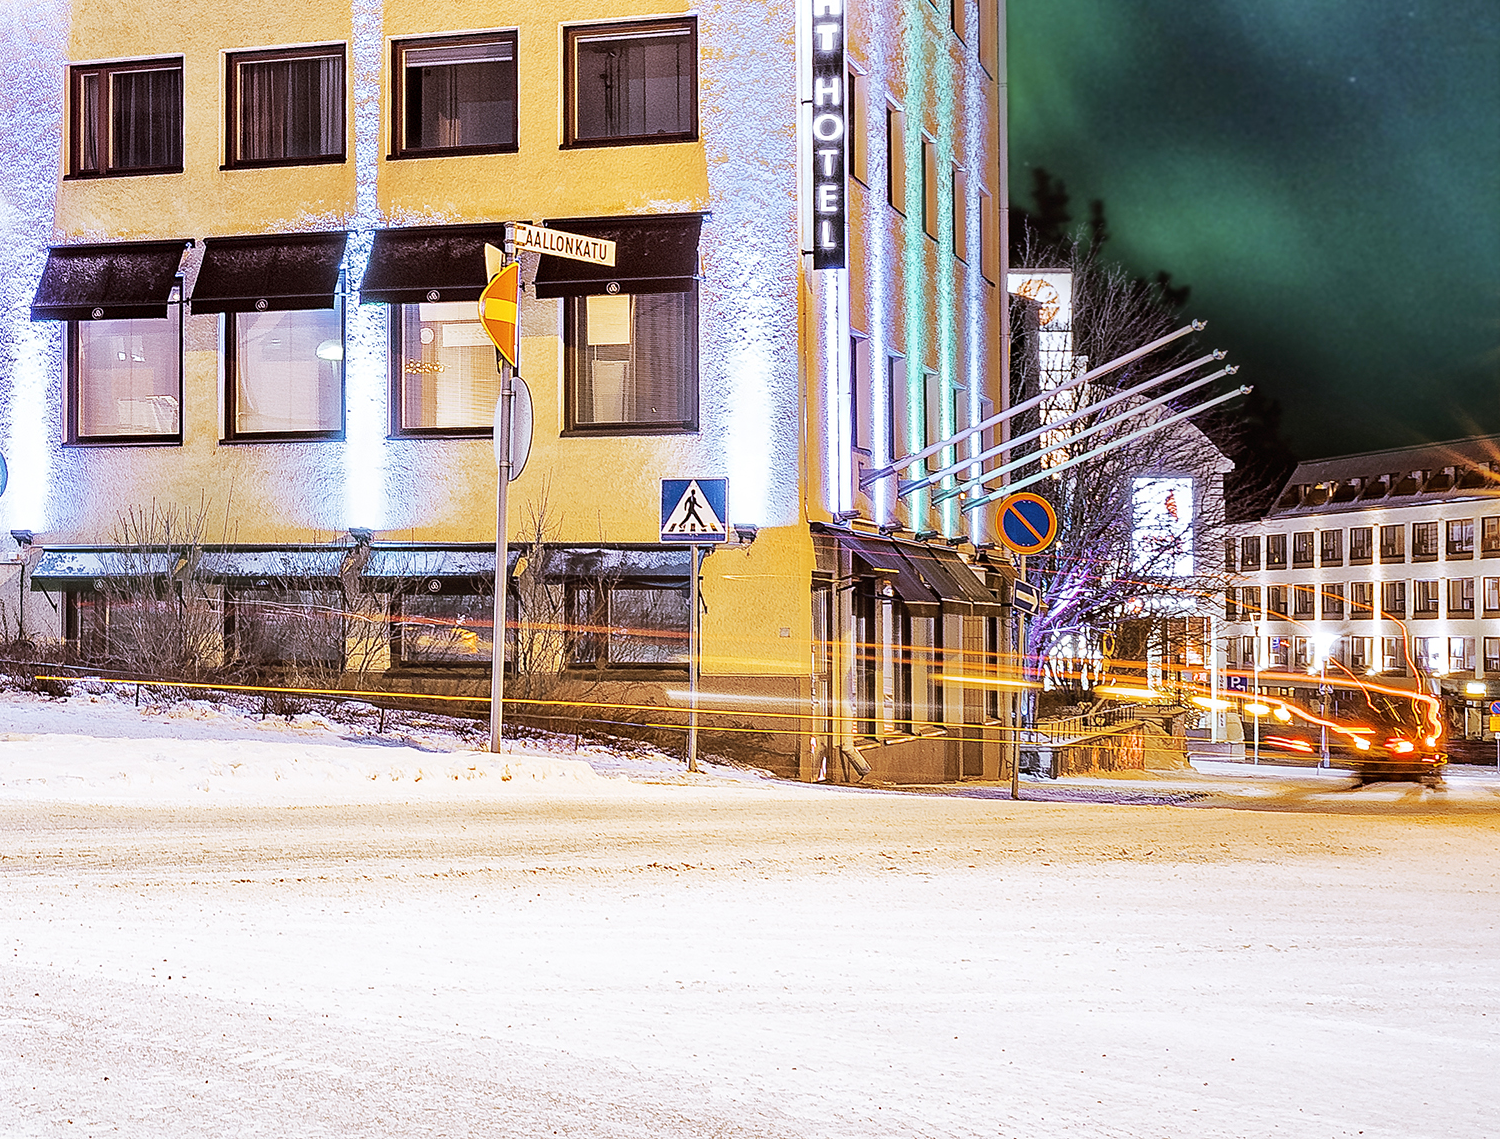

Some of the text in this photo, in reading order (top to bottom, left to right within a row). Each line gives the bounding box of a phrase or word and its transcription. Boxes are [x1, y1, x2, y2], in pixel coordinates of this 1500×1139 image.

[812, 77, 844, 249] HOTEL
[525, 229, 608, 261] AALLONKATU
[1231, 676, 1241, 688] P
